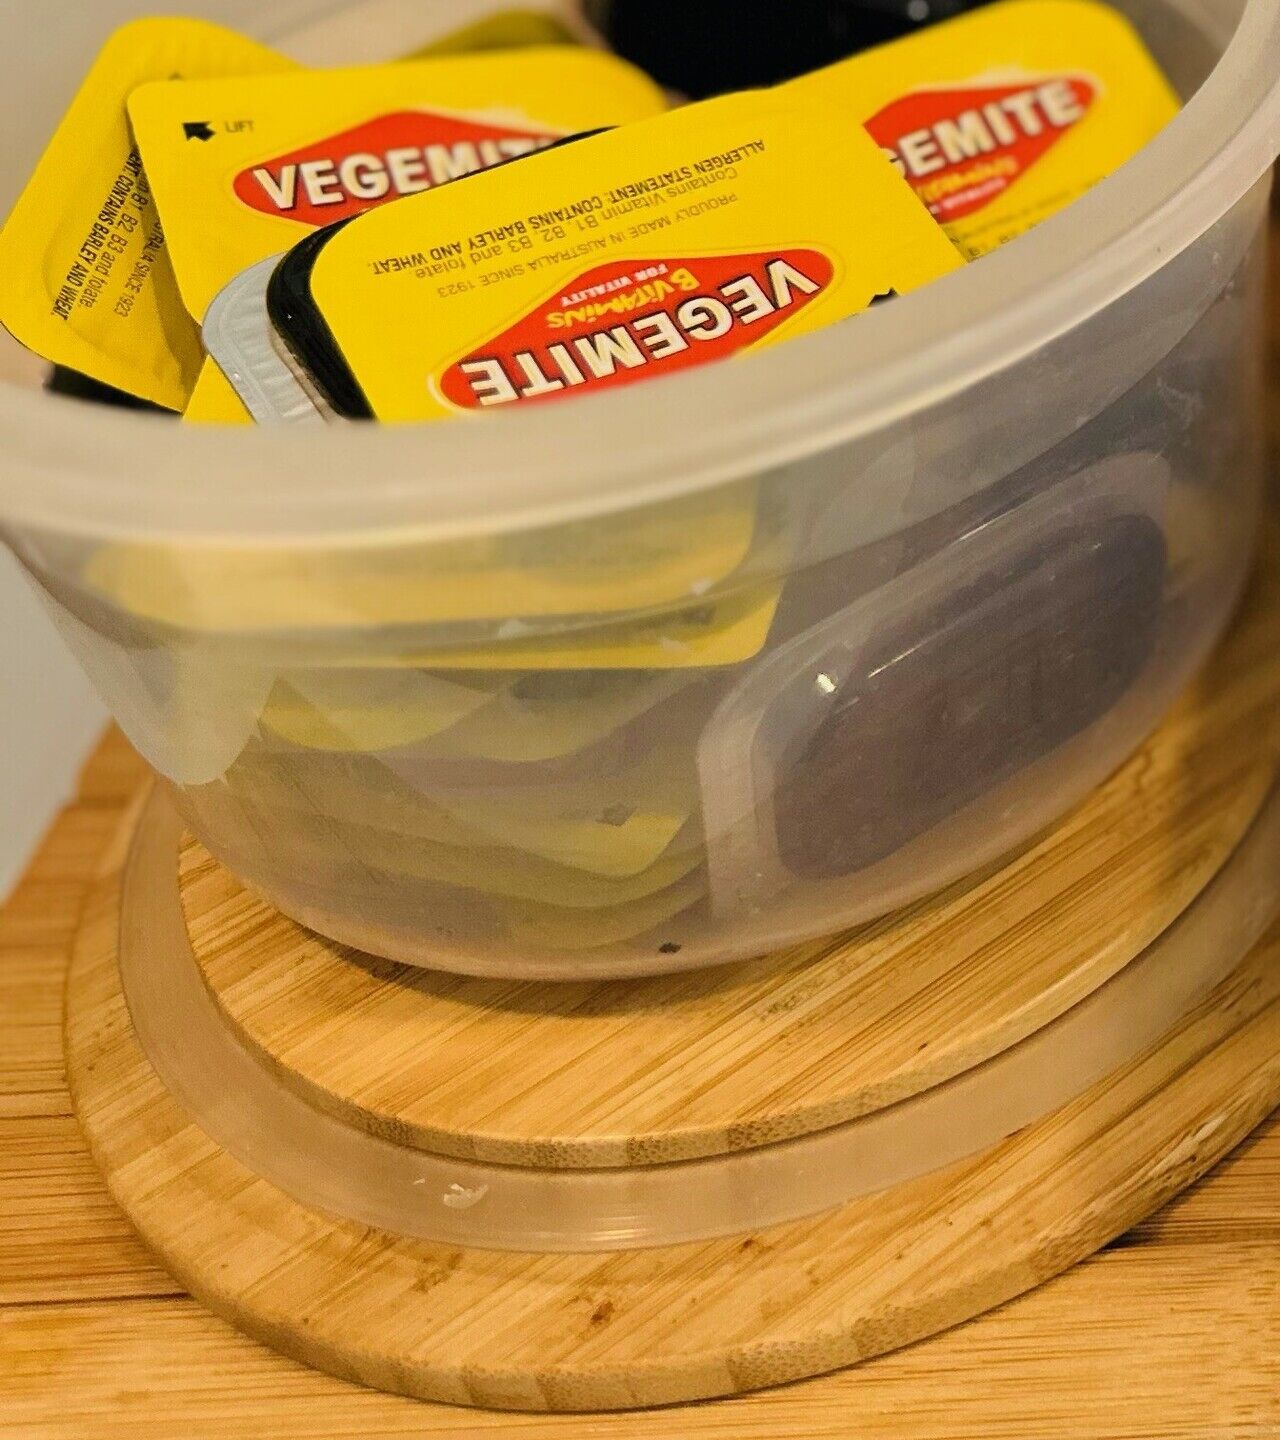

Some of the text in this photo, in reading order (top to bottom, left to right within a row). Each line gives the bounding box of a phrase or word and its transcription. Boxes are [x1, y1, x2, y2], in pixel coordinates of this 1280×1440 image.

[224, 120, 254, 134] LIFT
[878, 78, 1086, 178] EMITE
[692, 138, 766, 173] ALLERGEN
[252, 138, 557, 210] VEGEMI
[666, 166, 739, 199] Contains
[98, 173, 135, 227] CONTAINS
[527, 197, 604, 231] CONTAINS
[601, 192, 667, 221] Vitamin
[77, 221, 111, 267] BARLEY
[106, 233, 130, 255] B3
[429, 240, 463, 262] AND
[437, 192, 739, 299] PROUDLY MADE IN AUSTRALIA SINCE 1923
[467, 220, 528, 251] BARLEY
[508, 235, 534, 254] B3
[94, 251, 117, 277] and
[369, 252, 430, 276] WHEAT.
[469, 244, 504, 266] and
[65, 260, 91, 288] AND
[559, 262, 670, 309] FOR VITALITY
[669, 267, 701, 292] B
[459, 258, 821, 407] VEGEMITE
